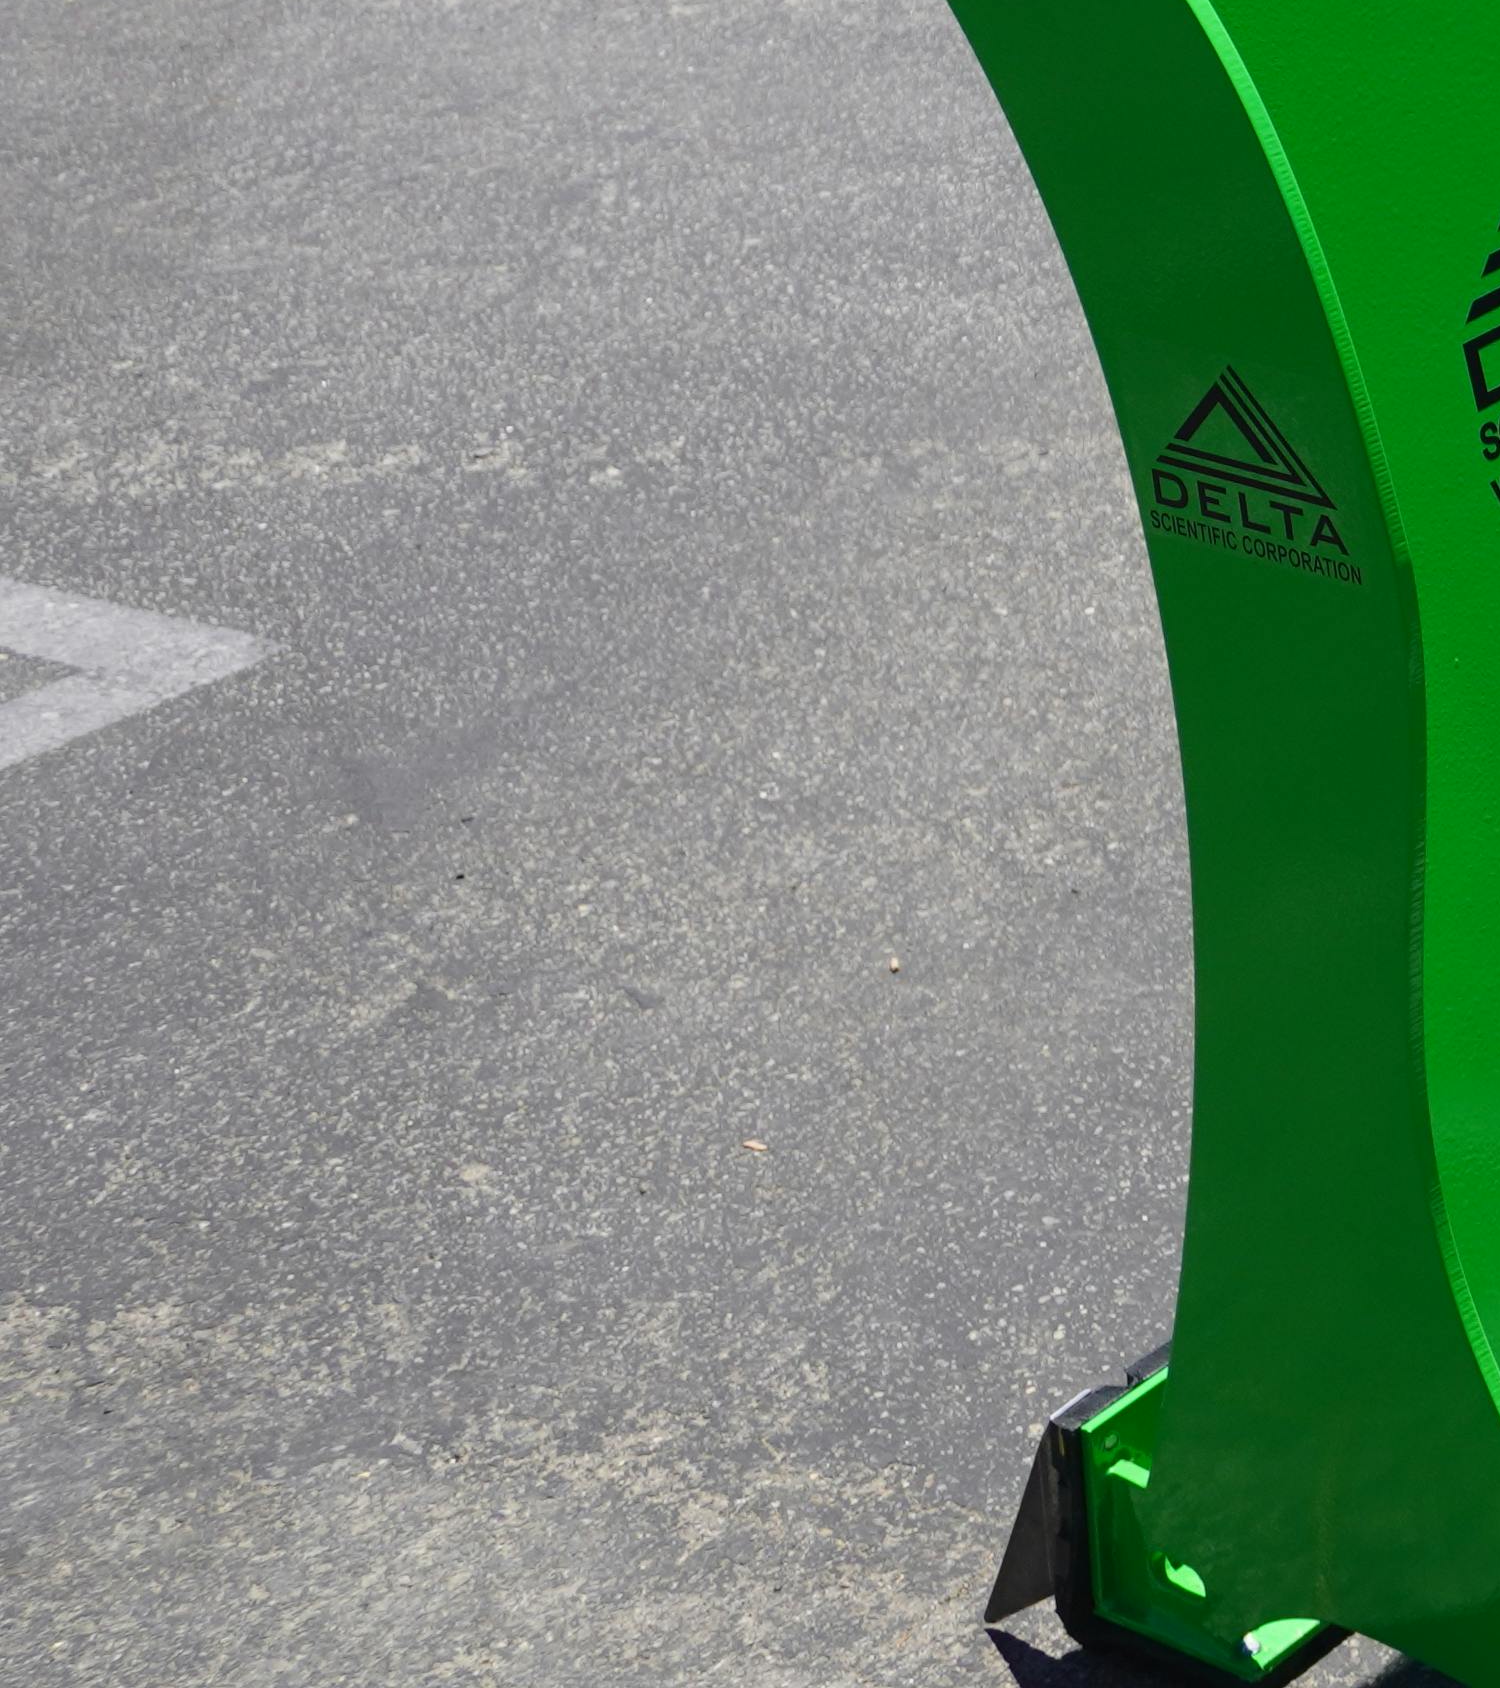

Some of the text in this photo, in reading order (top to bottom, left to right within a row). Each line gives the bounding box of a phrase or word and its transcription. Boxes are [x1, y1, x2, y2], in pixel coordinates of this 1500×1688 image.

[1150, 509, 1363, 586] SCIENTIFIC CORPORATION
[1151, 468, 1350, 557] DELTA
